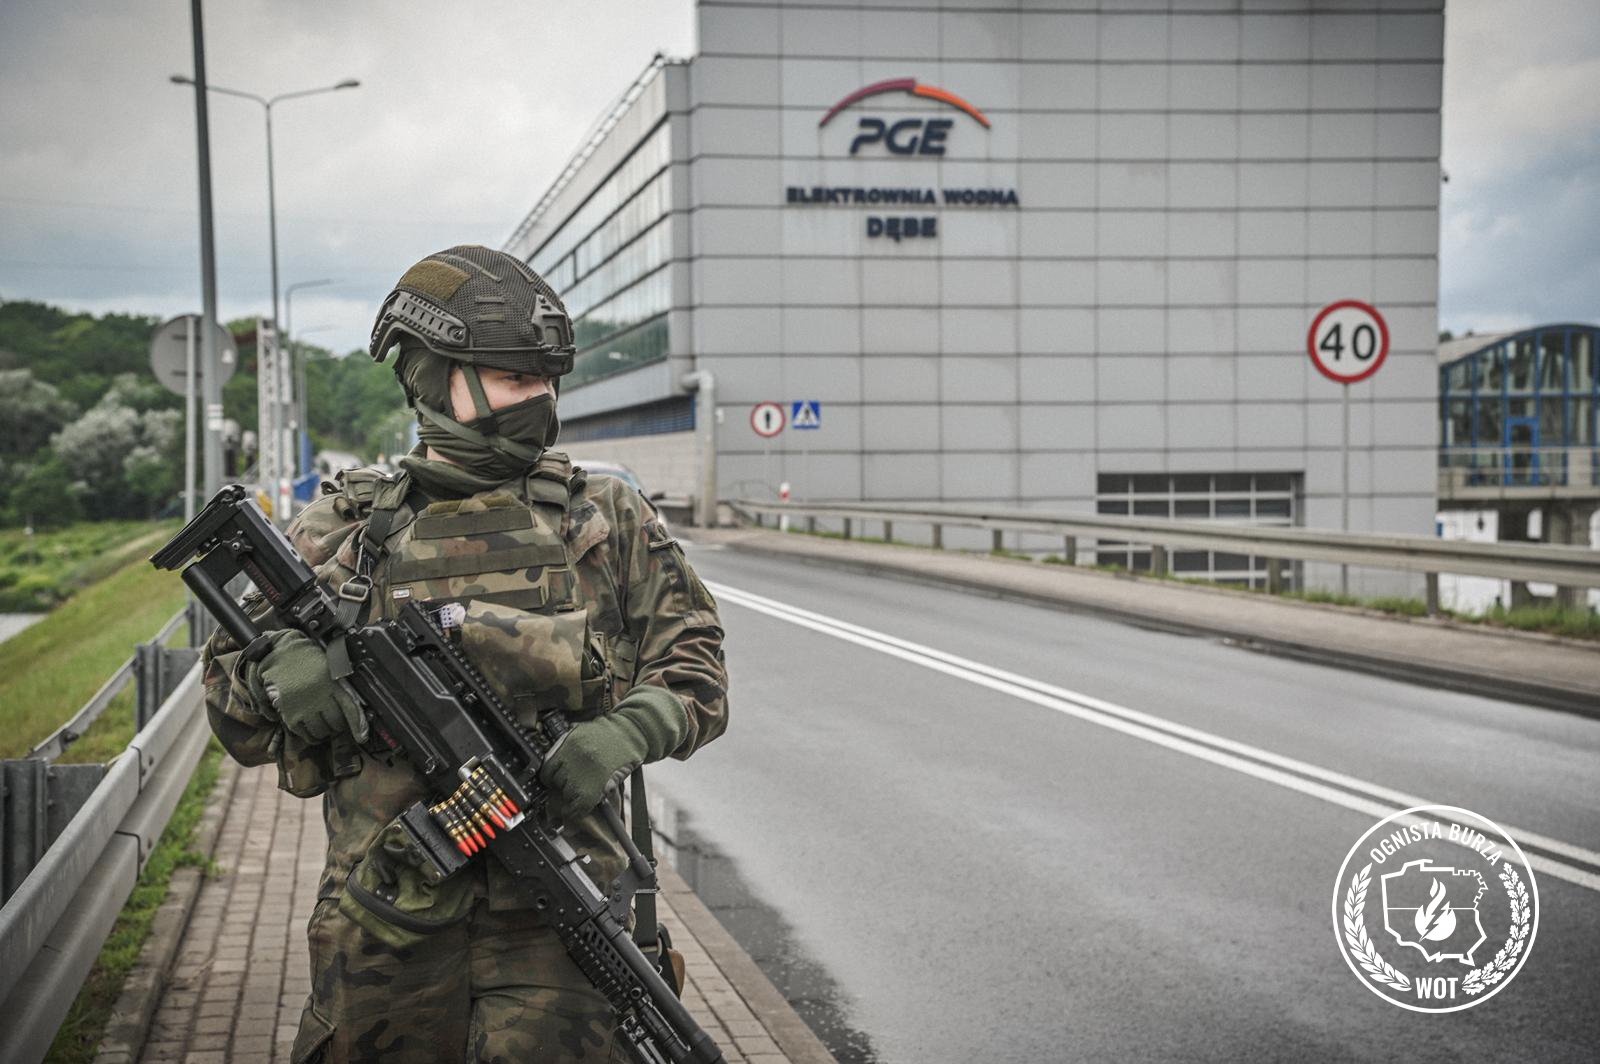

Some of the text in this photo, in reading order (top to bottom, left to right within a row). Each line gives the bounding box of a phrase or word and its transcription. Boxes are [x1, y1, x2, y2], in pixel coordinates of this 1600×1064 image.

[849, 117, 955, 155] PGE
[786, 186, 1019, 206] ELEKTROWNIA WODNA
[866, 216, 938, 242] DĘBE
[1319, 322, 1376, 361] 40
